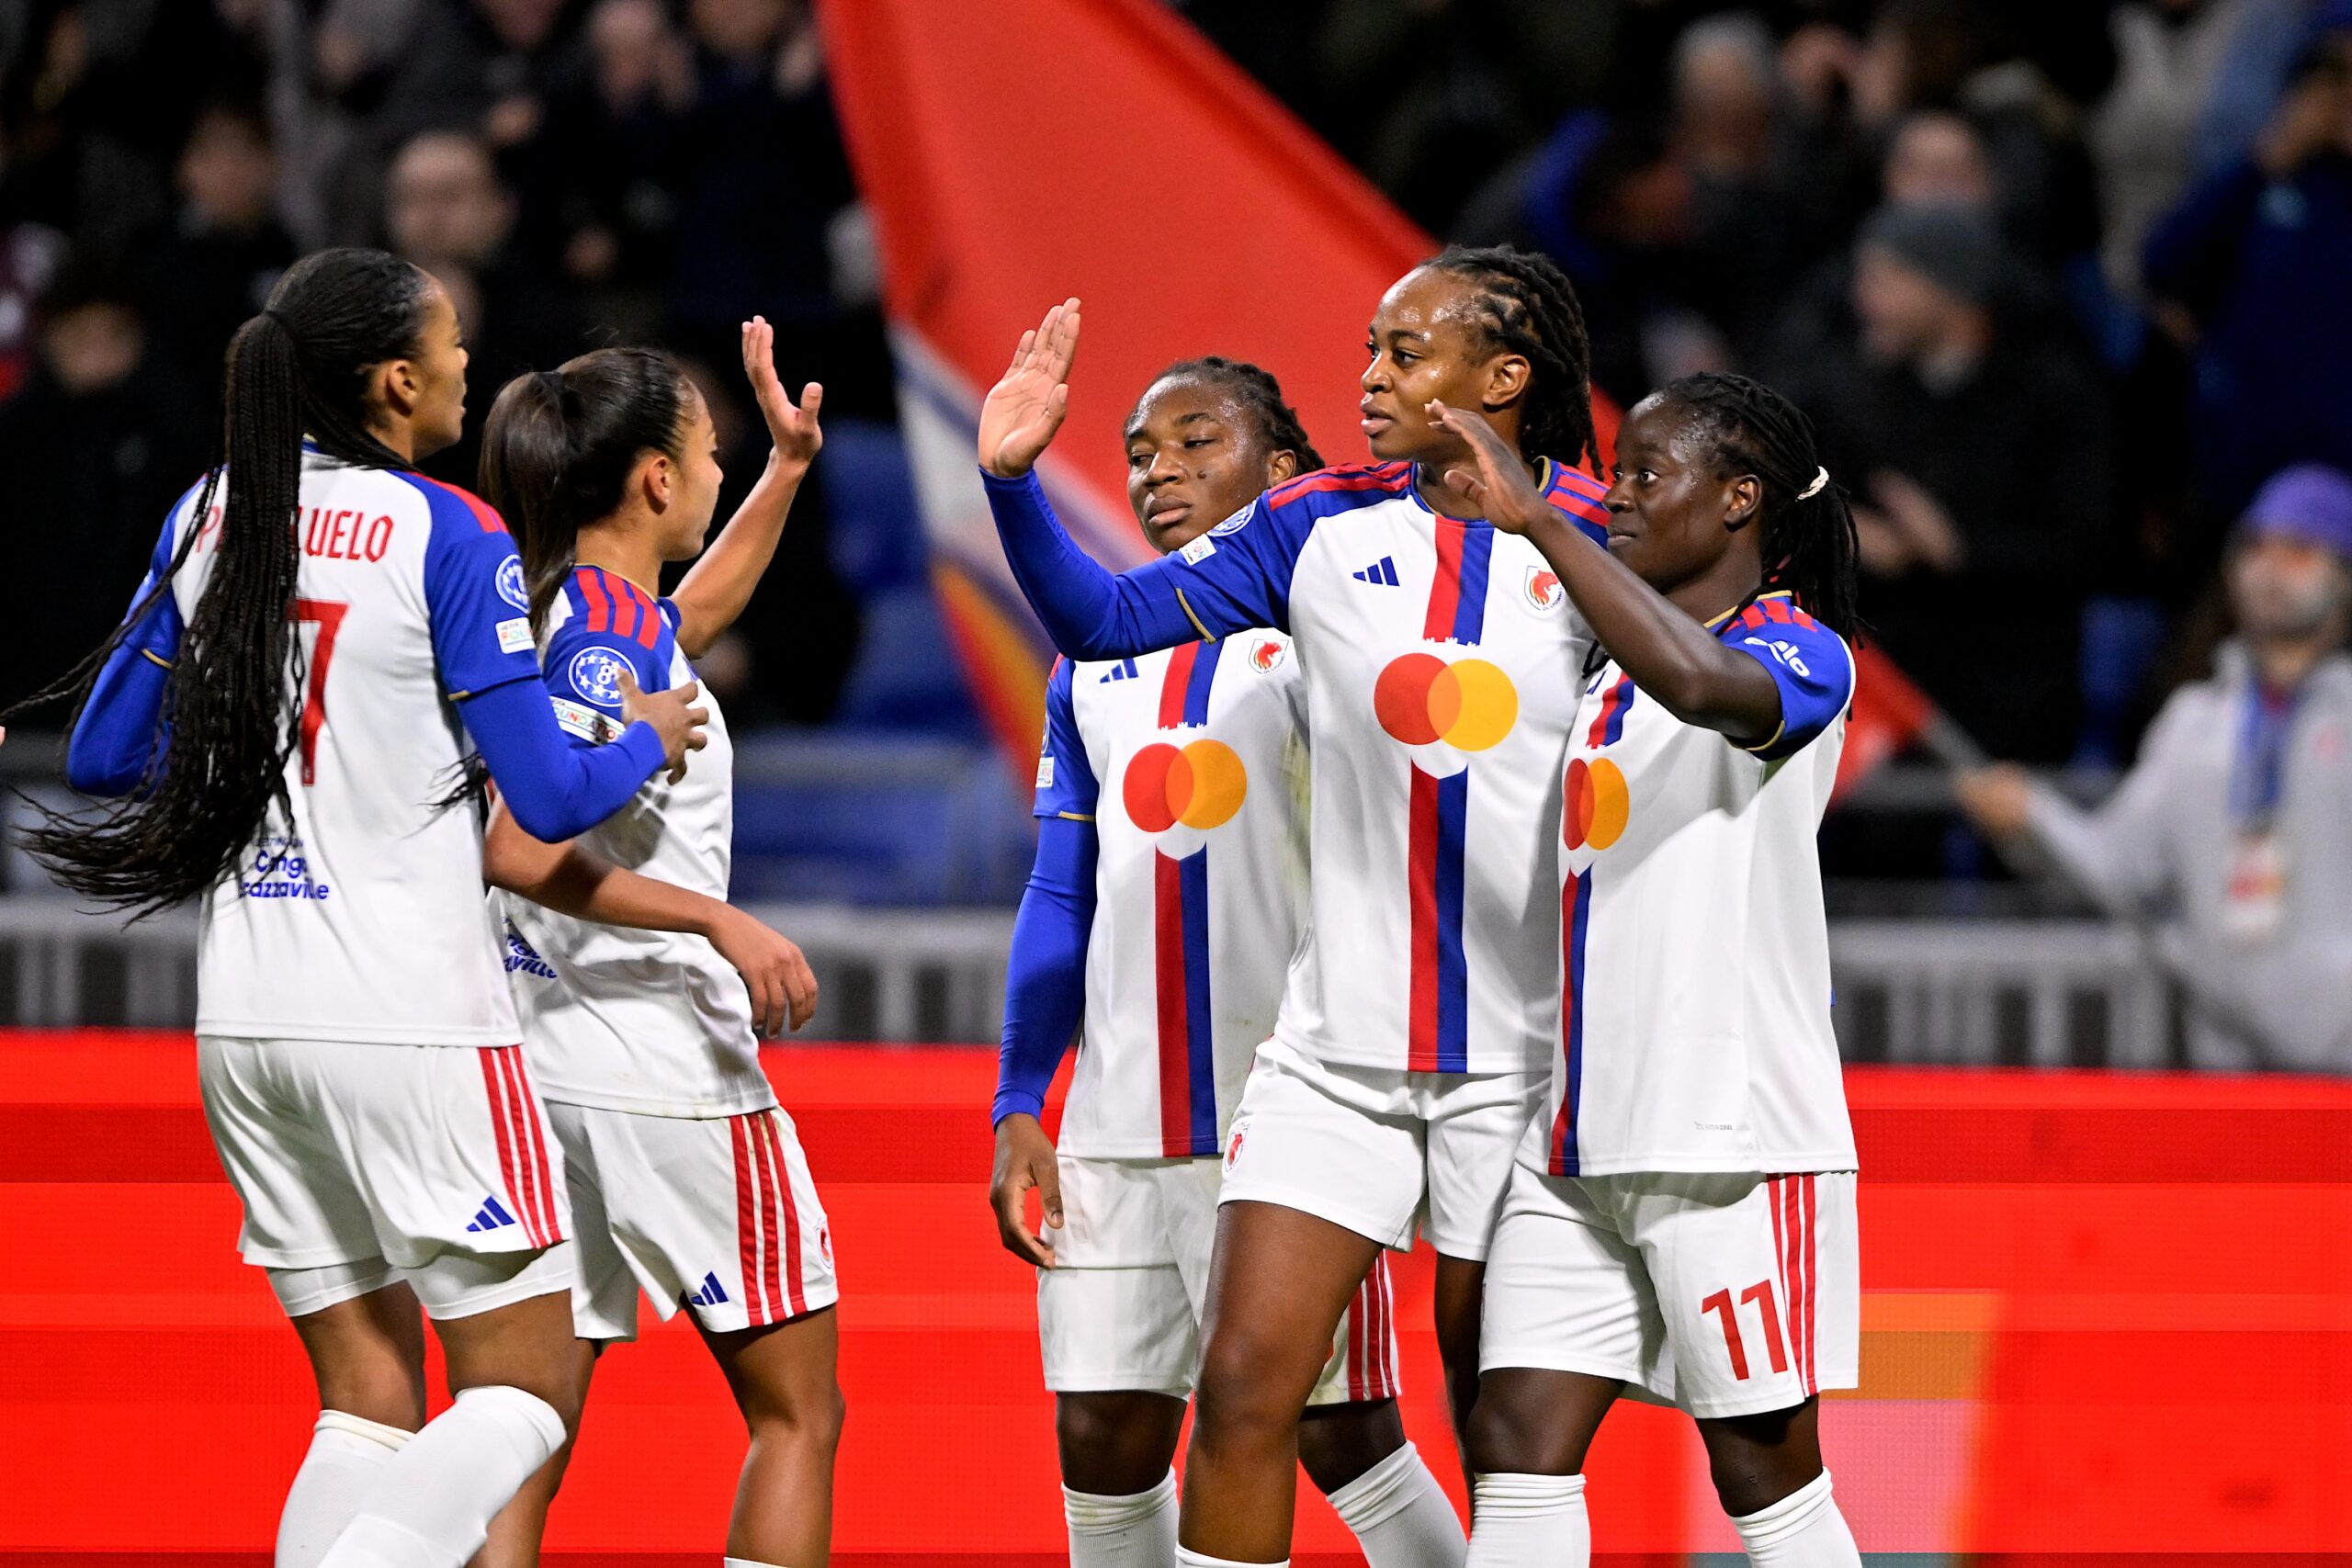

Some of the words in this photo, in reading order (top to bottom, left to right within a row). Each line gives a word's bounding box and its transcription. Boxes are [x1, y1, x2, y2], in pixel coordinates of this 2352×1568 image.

[288, 598, 351, 787] 7
[596, 664, 613, 685] 8
[1702, 1278, 1788, 1382] 11
